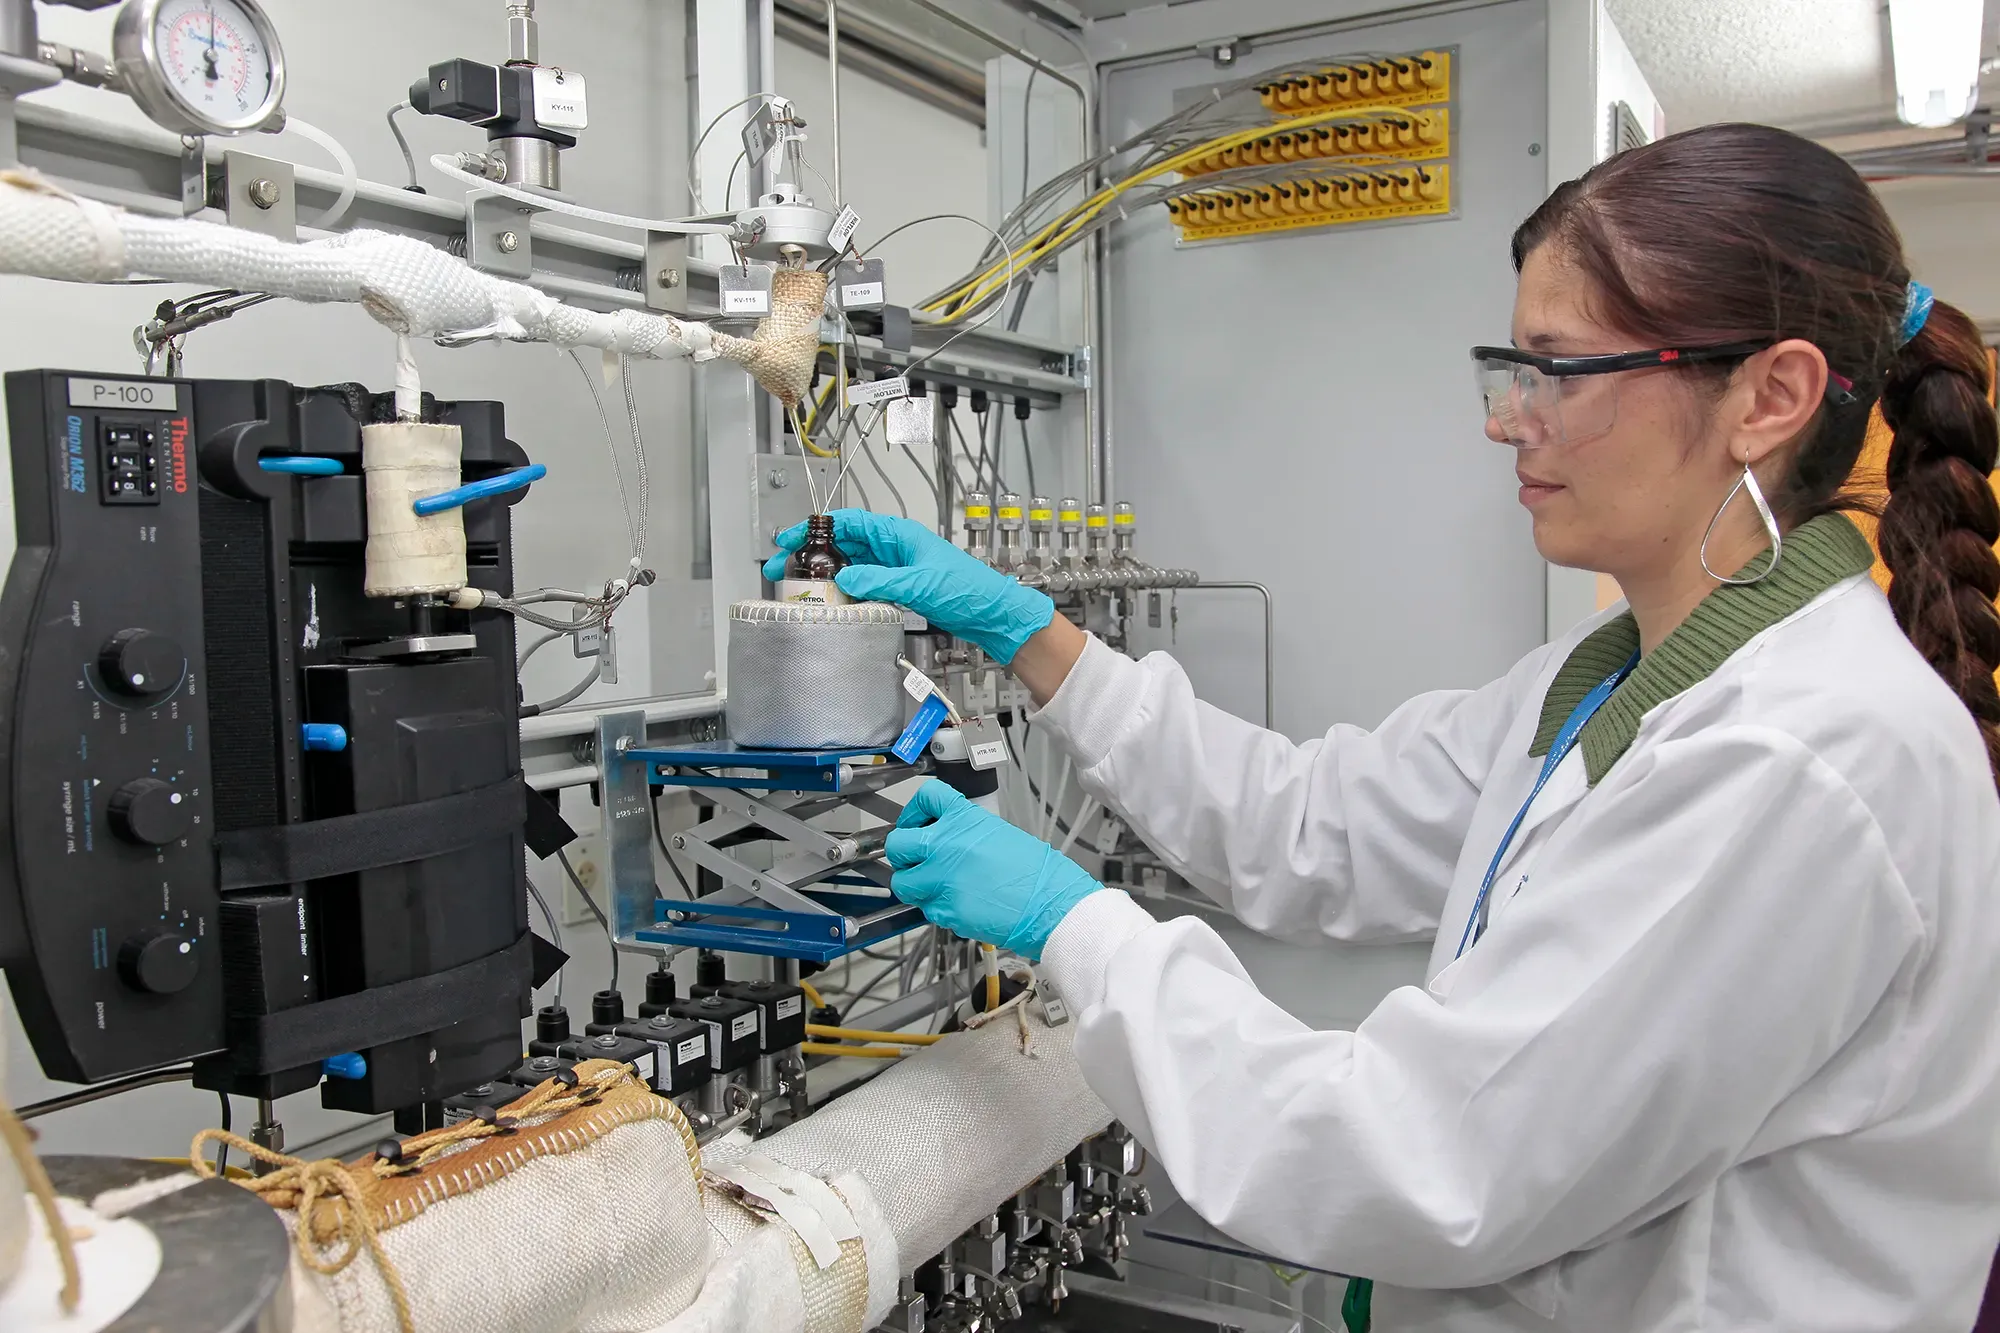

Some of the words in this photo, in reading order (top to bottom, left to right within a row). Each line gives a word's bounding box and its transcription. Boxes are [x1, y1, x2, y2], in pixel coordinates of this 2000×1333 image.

[552, 104, 574, 112] KY-115
[843, 216, 858, 238] WATLOW
[1660, 350, 1678, 362] 3M
[94, 385, 154, 403] P-100
[874, 388, 902, 398] WATLOW
[68, 416, 82, 455] ORION
[162, 420, 172, 491] SCIENTIFIC
[171, 417, 188, 494] Thermo
[70, 456, 86, 493] M362
[72, 601, 80, 627] range
[77, 680, 84, 689] X1
[977, 748, 997, 756] HTR-100
[63, 782, 72, 814] syringe
[66, 816, 74, 833] size
[68, 840, 76, 854] mL
[96, 1002, 106, 1029] power
